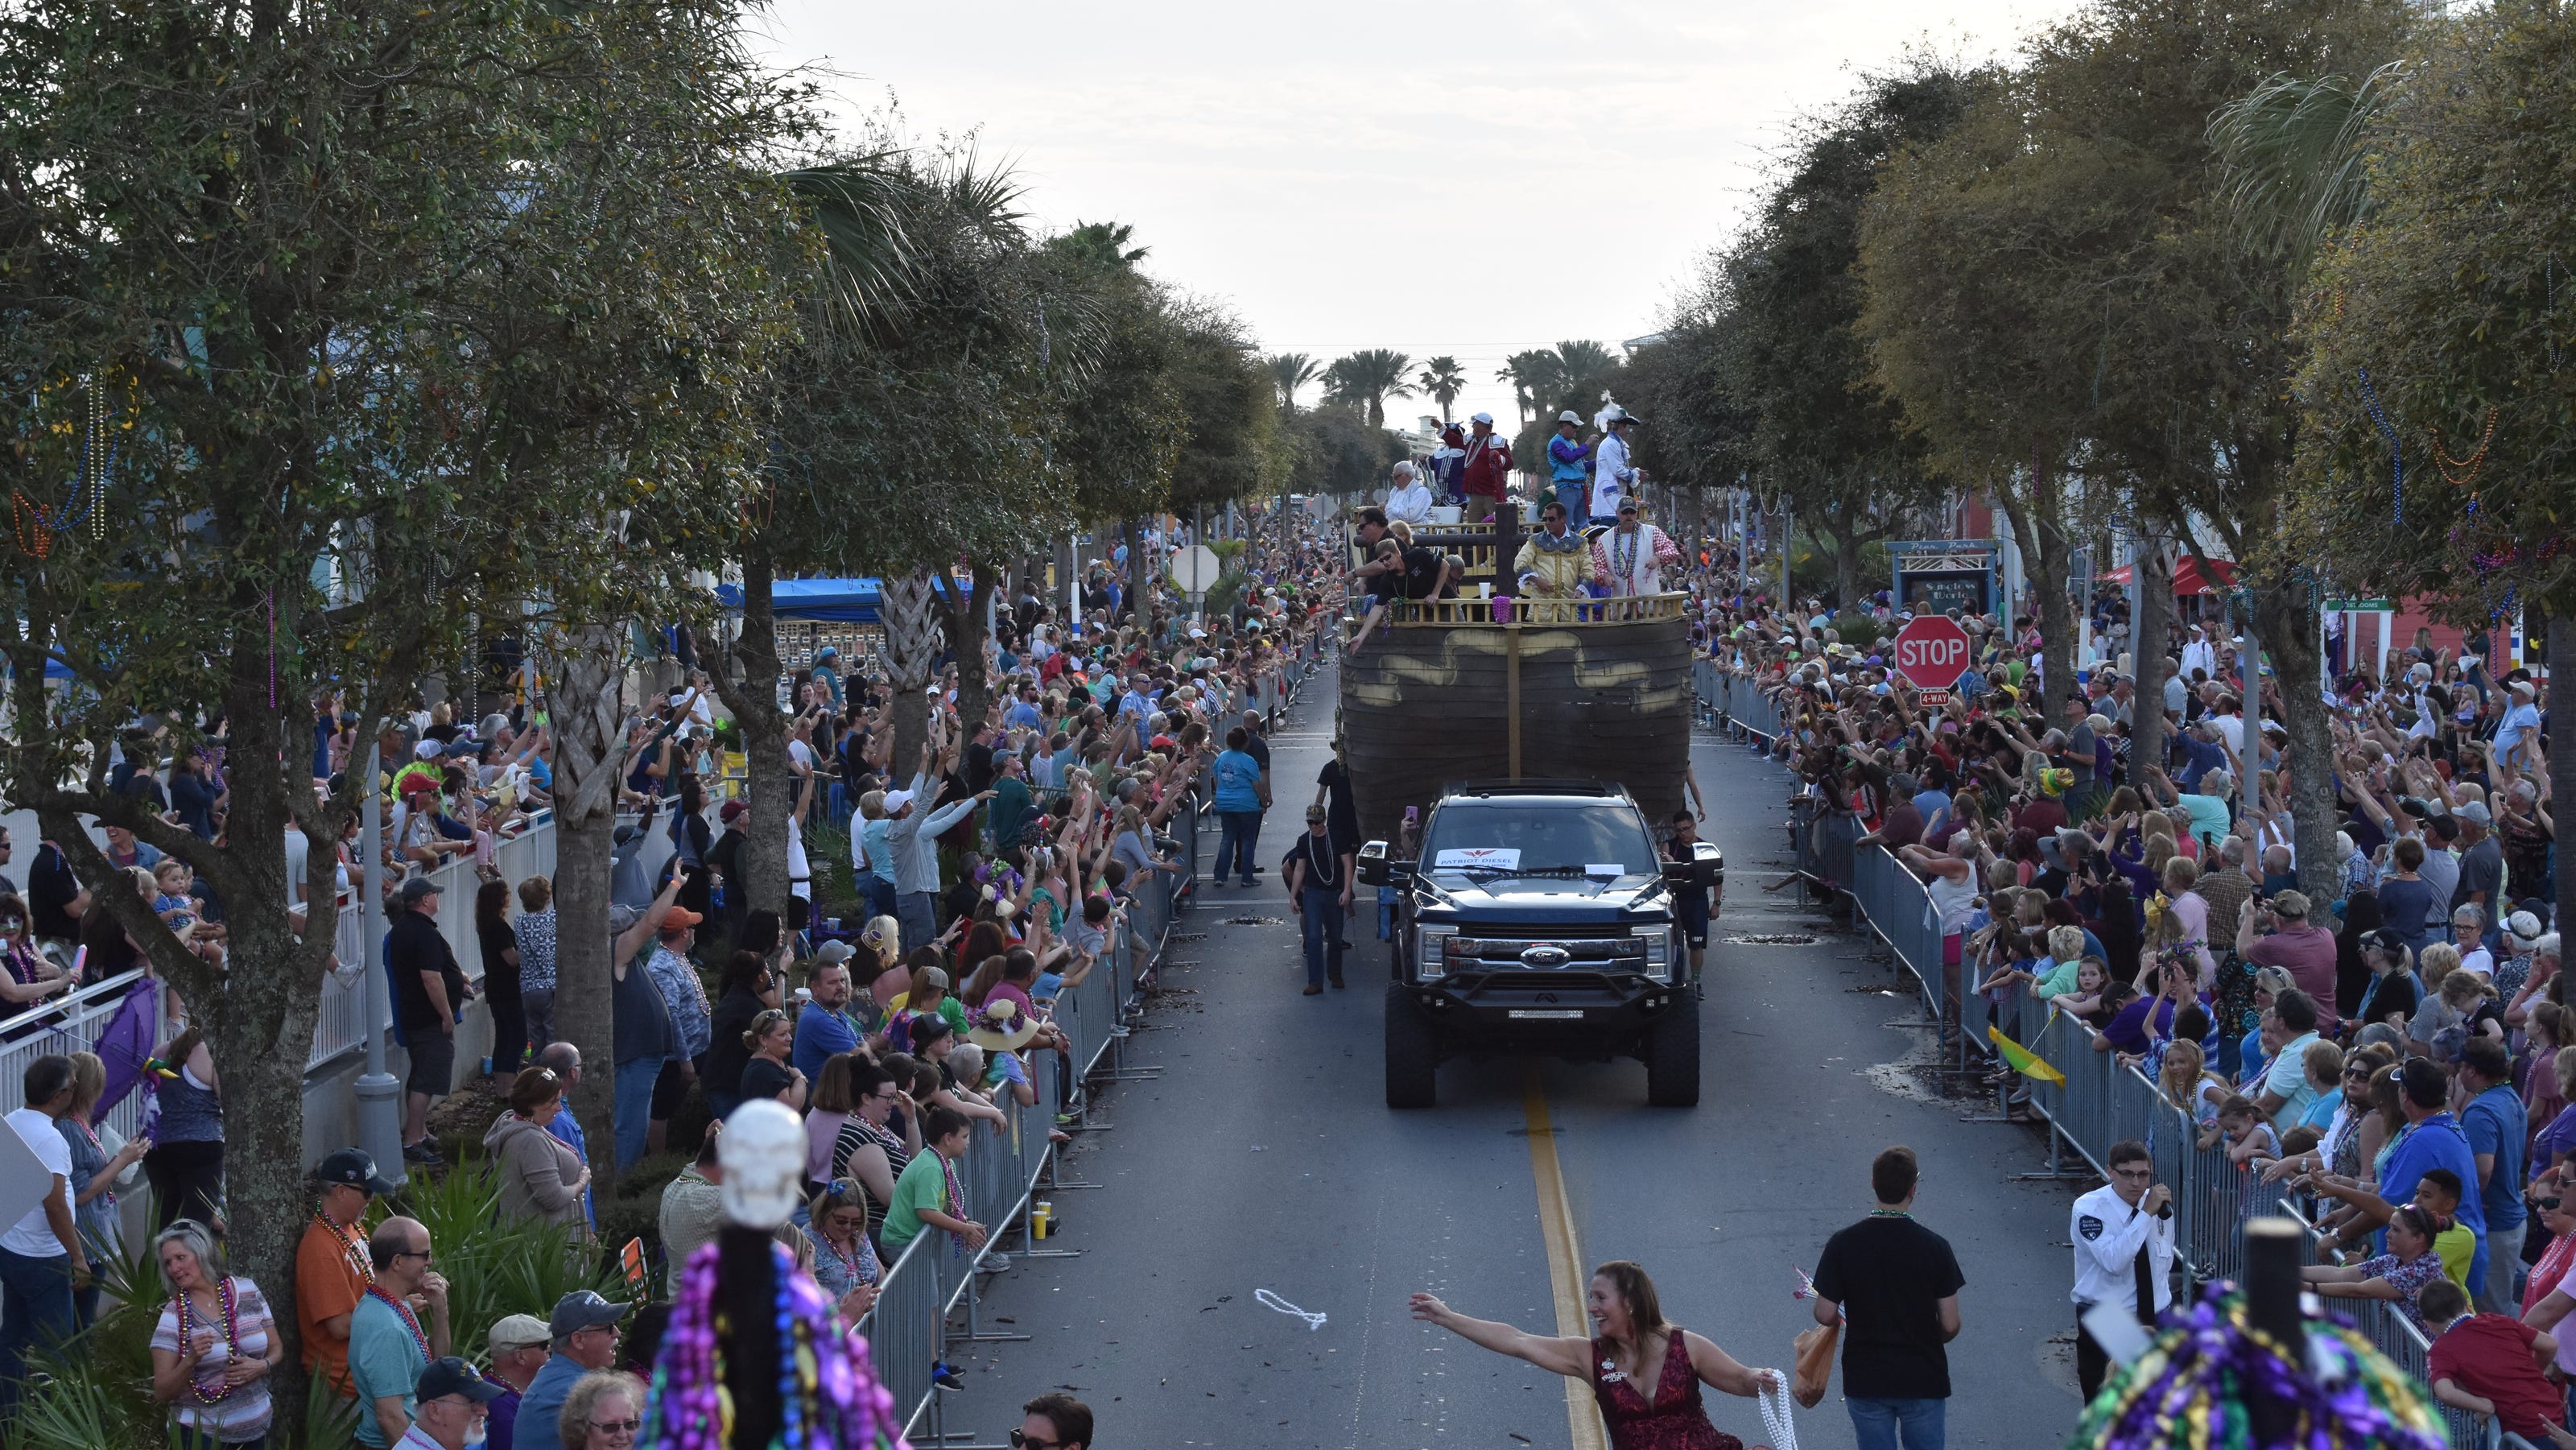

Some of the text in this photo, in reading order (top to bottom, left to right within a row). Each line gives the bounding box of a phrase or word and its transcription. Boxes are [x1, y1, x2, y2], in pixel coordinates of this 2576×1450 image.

[1948, 541, 1978, 549] Park
[1901, 639, 1964, 667] STOP
[1922, 694, 1947, 703] 4-WAY
[1534, 952, 1556, 963] Ford
